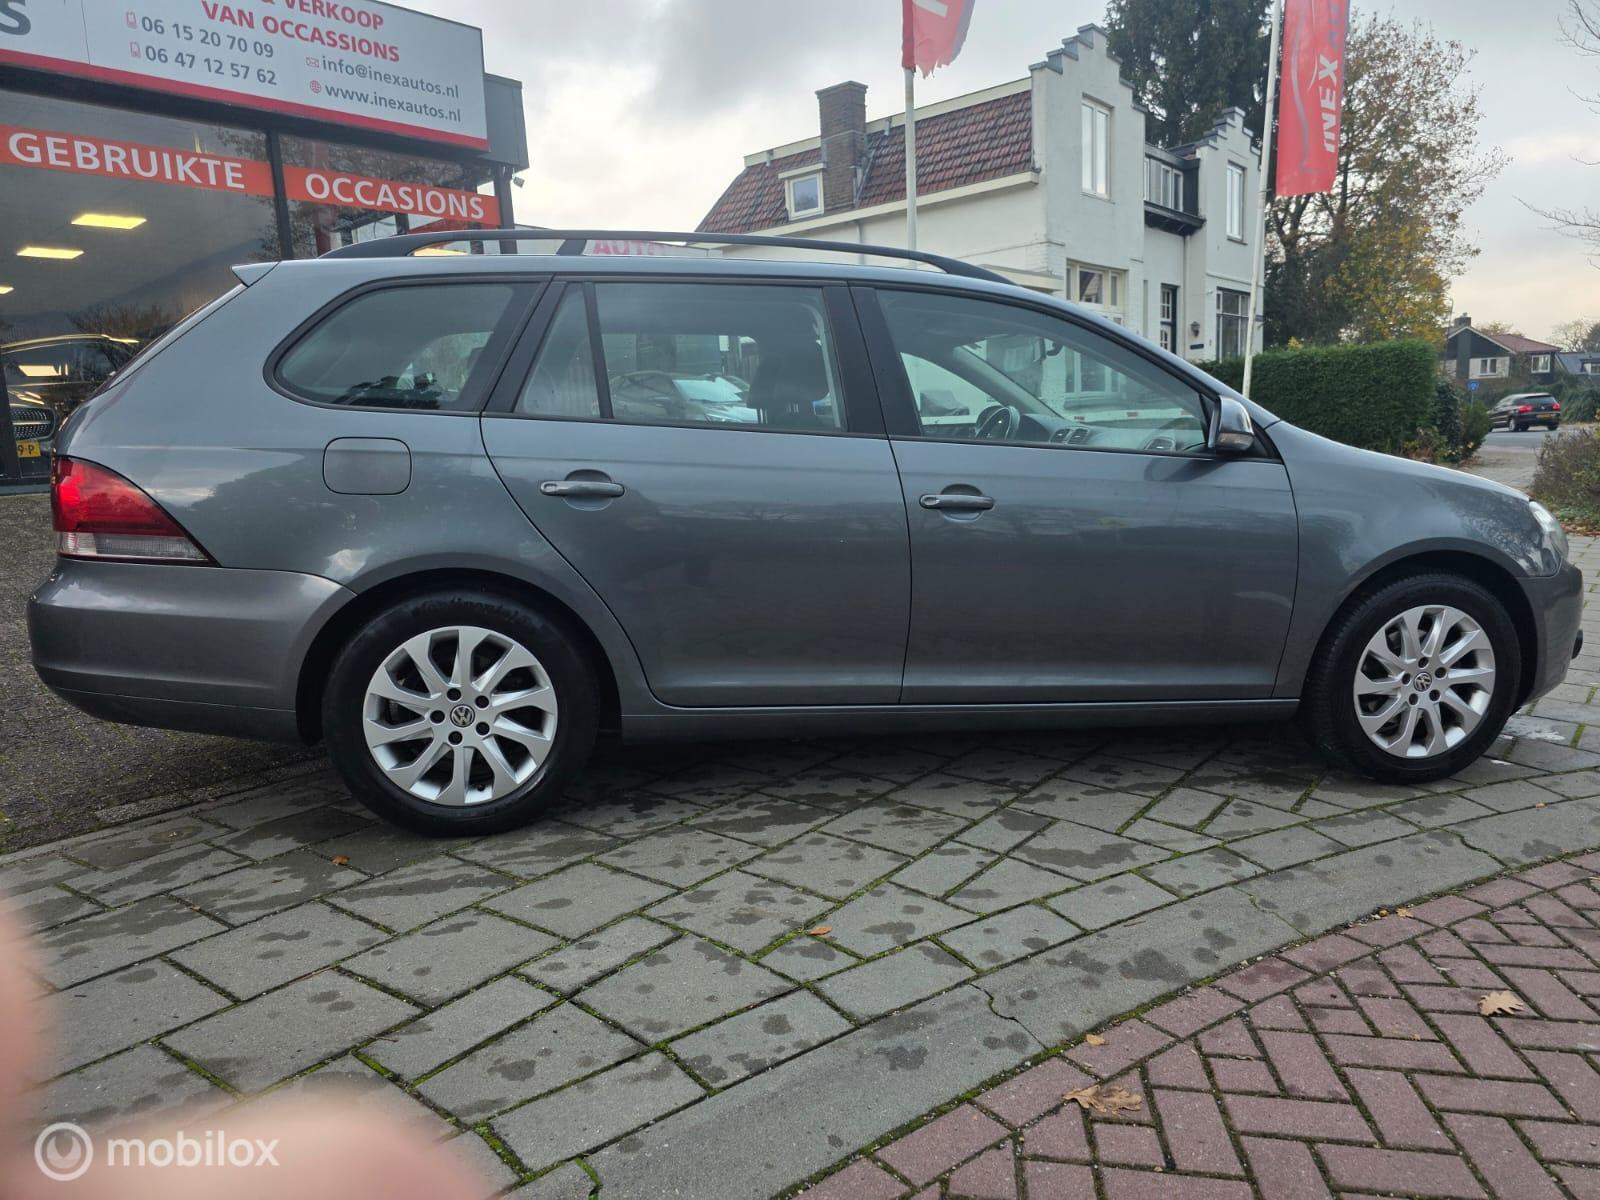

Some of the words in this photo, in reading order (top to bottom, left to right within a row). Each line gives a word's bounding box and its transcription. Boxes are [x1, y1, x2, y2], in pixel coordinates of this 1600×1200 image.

[141, 16, 165, 35] 06
[172, 23, 193, 41] 15
[199, 28, 221, 47] 20
[226, 34, 248, 53] 70
[253, 41, 274, 58] 09
[201, 0, 255, 29] VAN
[262, 15, 400, 62] OCCASSIONS
[145, 45, 168, 64] 06
[174, 52, 196, 69] 47
[203, 57, 225, 75] 12
[230, 63, 250, 80] 57
[256, 68, 277, 86] 62
[322, 55, 459, 99] info@inexautos.nl
[325, 84, 461, 122] www.inexautos.nl
[1318, 54, 1338, 153] INEX
[8, 132, 245, 189] GEBRUIKTE
[305, 173, 485, 220] OCCASIONS
